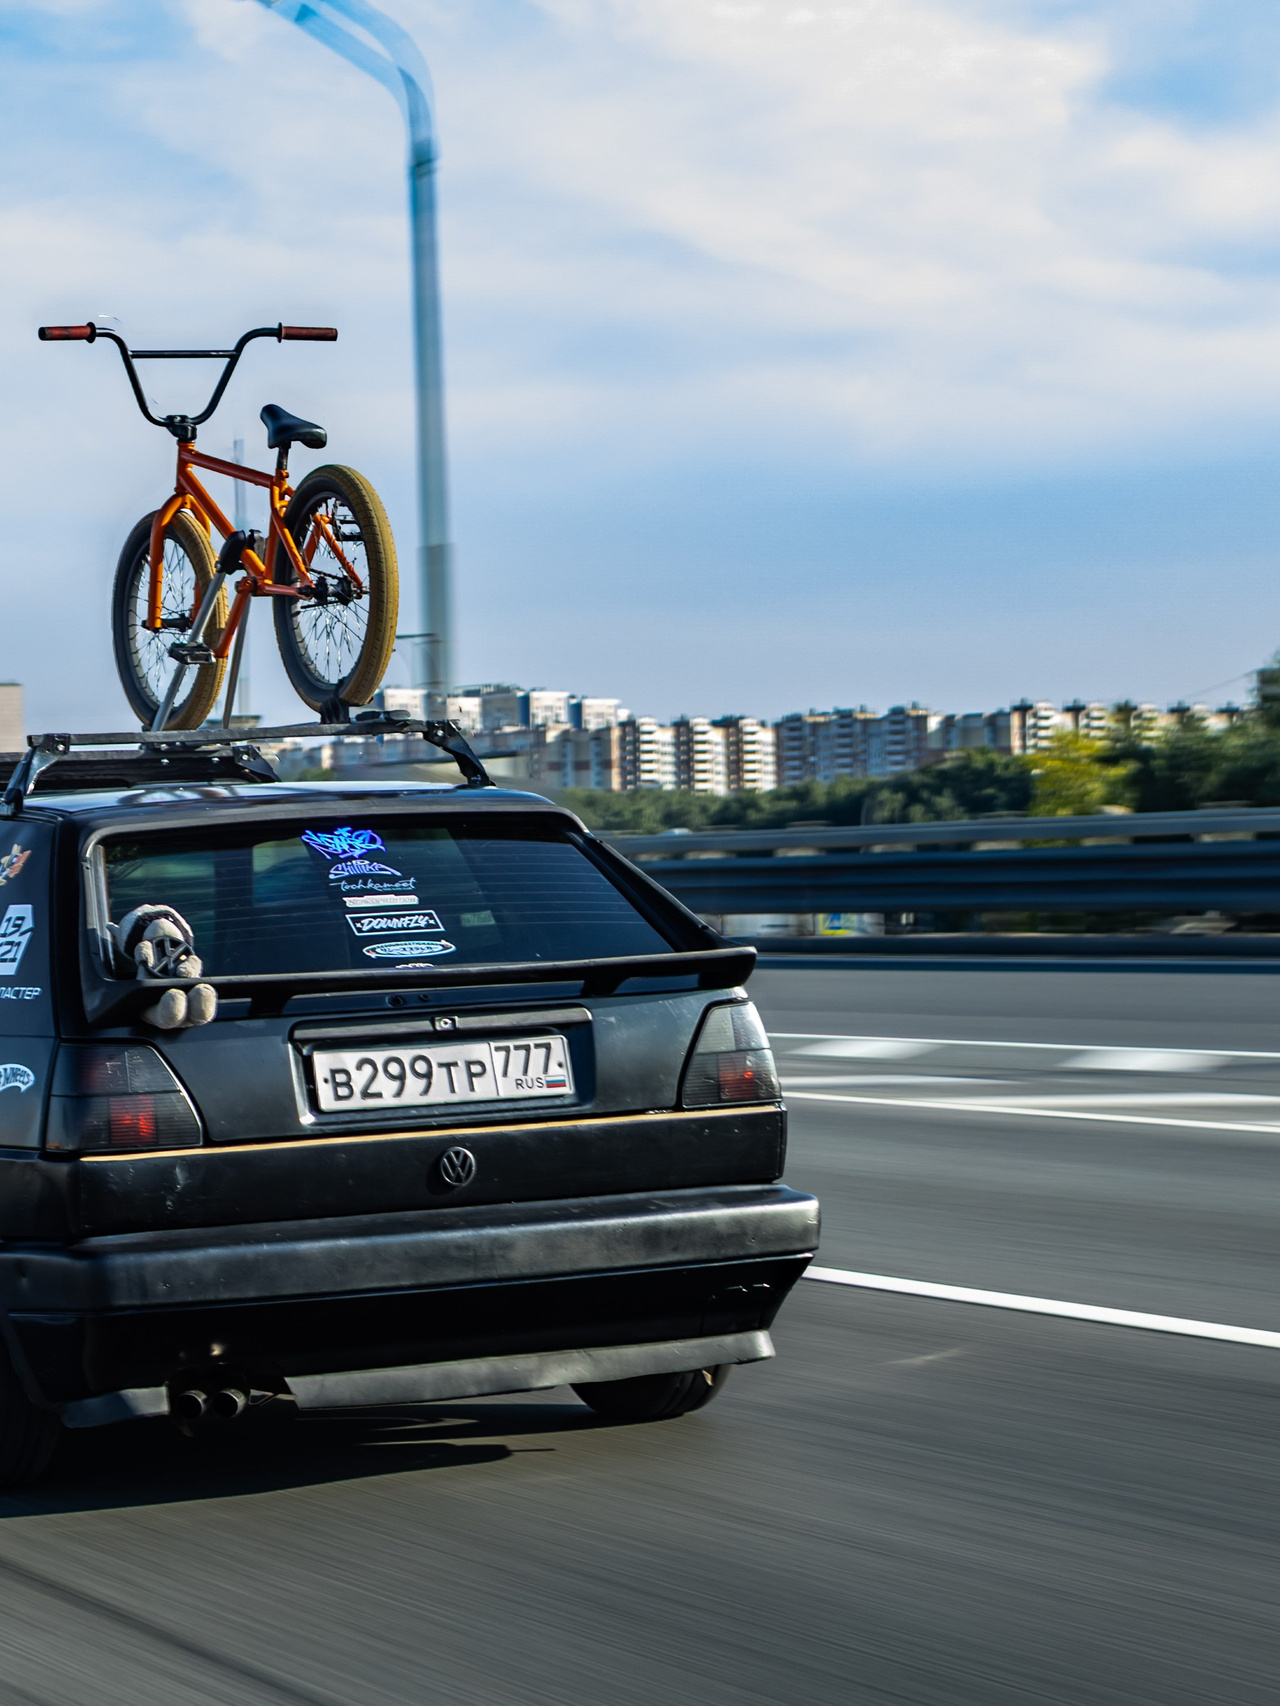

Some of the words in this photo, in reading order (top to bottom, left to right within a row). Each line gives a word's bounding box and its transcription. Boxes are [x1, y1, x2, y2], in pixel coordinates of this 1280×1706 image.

[0, 916, 26, 937] 19
[494, 1042, 552, 1077] 777
[516, 1076, 544, 1089] RUS
